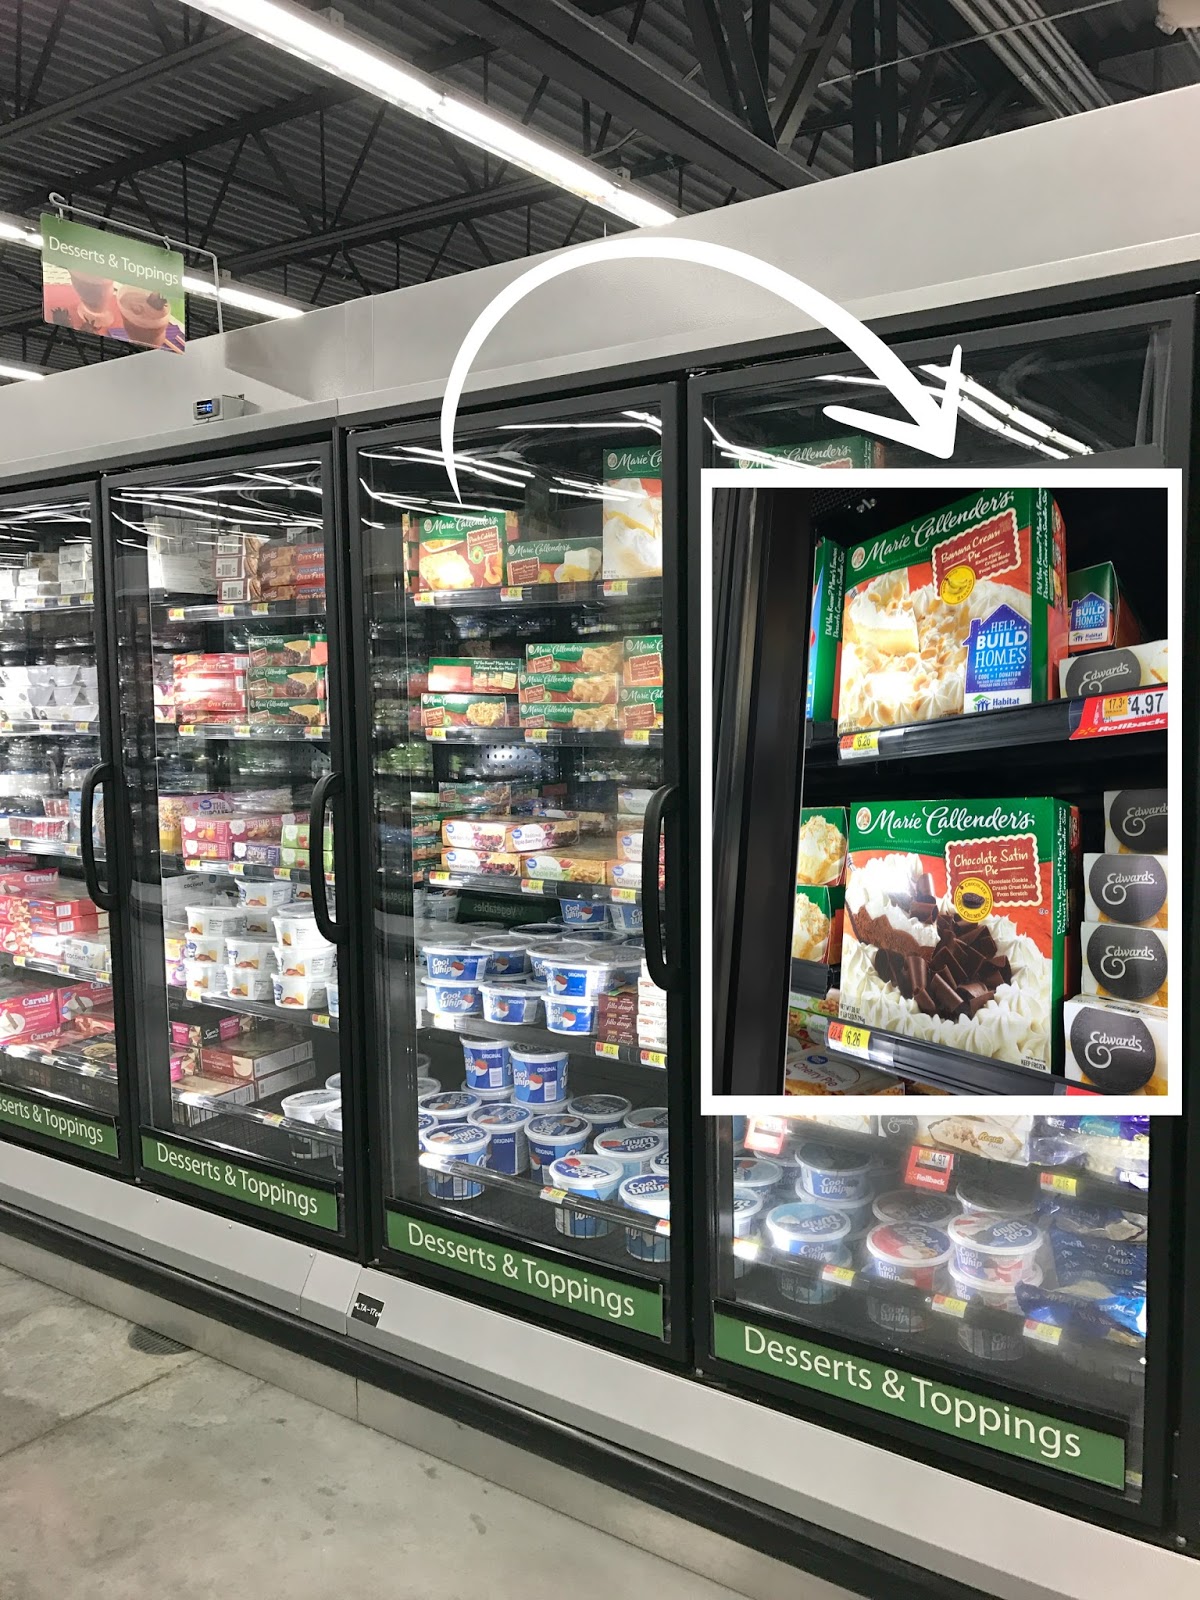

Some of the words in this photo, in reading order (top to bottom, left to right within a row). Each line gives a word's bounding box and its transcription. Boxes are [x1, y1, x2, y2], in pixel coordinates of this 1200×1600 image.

[49, 235, 105, 265] Desserts
[108, 253, 119, 269] &
[121, 256, 179, 286] Toppings
[616, 452, 648, 471] Marie
[431, 519, 455, 532] Marie
[860, 536, 911, 565] Marie
[911, 491, 1015, 548] Callender's
[514, 545, 534, 557] Marie
[534, 543, 571, 555] Callender's
[941, 545, 971, 563] Banana
[972, 530, 1000, 548] Cream
[968, 550, 980, 562] Pie
[828, 570, 836, 590] Marie's
[1076, 606, 1105, 617] BUILD
[991, 620, 1015, 633] HELP
[1075, 614, 1105, 627] HOMES
[976, 630, 1028, 650] BUILD
[535, 645, 551, 656] Marie
[633, 640, 655, 653] Marie
[975, 647, 1027, 668] HOMES
[527, 675, 543, 685] Marie
[1079, 662, 1132, 689] Edwards
[627, 690, 649, 702] Marie
[992, 697, 1020, 706] Habitat
[527, 705, 543, 715] Marie
[1098, 718, 1166, 732] Rollback
[213, 802, 226, 810] THE
[865, 807, 922, 838] Marie
[922, 805, 1035, 837] Callender's
[954, 851, 998, 867] Chocolate
[1000, 848, 1028, 863] Satin
[985, 865, 998, 876] Pie
[24, 873, 53, 883] Carvel
[617, 878, 637, 887] Cherry
[1102, 871, 1157, 897] Edwards
[566, 904, 580, 912] Cool
[565, 911, 582, 920] Whip
[432, 957, 450, 967] Cool
[1101, 945, 1157, 970] Edwards
[432, 965, 451, 975] Whip
[22, 994, 49, 1006] Carvel
[440, 991, 461, 1001] Cool
[439, 999, 462, 1010] Whip
[606, 1002, 617, 1010] fillo
[618, 1004, 634, 1012] dough
[30, 1030, 55, 1042] Carvel
[1085, 1031, 1145, 1059] Edwards
[1031, 1062, 1046, 1070] FROZEN
[513, 1069, 528, 1078] Cool
[794, 1063, 822, 1079] Cherry
[822, 1076, 838, 1086] Pie
[0, 1098, 30, 1119] serts
[33, 1104, 42, 1123] &
[42, 1107, 103, 1145] Toppings
[461, 1134, 484, 1144] Cool
[534, 1147, 555, 1156] ORIGINAL
[932, 1154, 946, 1165] 4.97
[157, 1142, 221, 1181] Desserts
[225, 1165, 236, 1187] &
[238, 1169, 318, 1216] Toppings
[628, 1180, 657, 1189] Cool
[822, 1178, 845, 1186] Cool
[917, 1174, 945, 1186] Rollback
[628, 1184, 665, 1195] Whip
[820, 1184, 850, 1195] Whip
[992, 1220, 1027, 1237] Whip
[1004, 1227, 1033, 1243] Cool
[801, 1243, 824, 1254] Cool
[960, 1247, 979, 1259] Cool
[878, 1262, 897, 1273] Cool
[960, 1256, 983, 1269] Whip
[408, 1222, 496, 1272] Desserts
[502, 1254, 519, 1280] &
[522, 1258, 635, 1318] Toppings
[744, 1325, 872, 1391] Desserts
[882, 1368, 906, 1402] &
[910, 1376, 1082, 1459] Toppings
